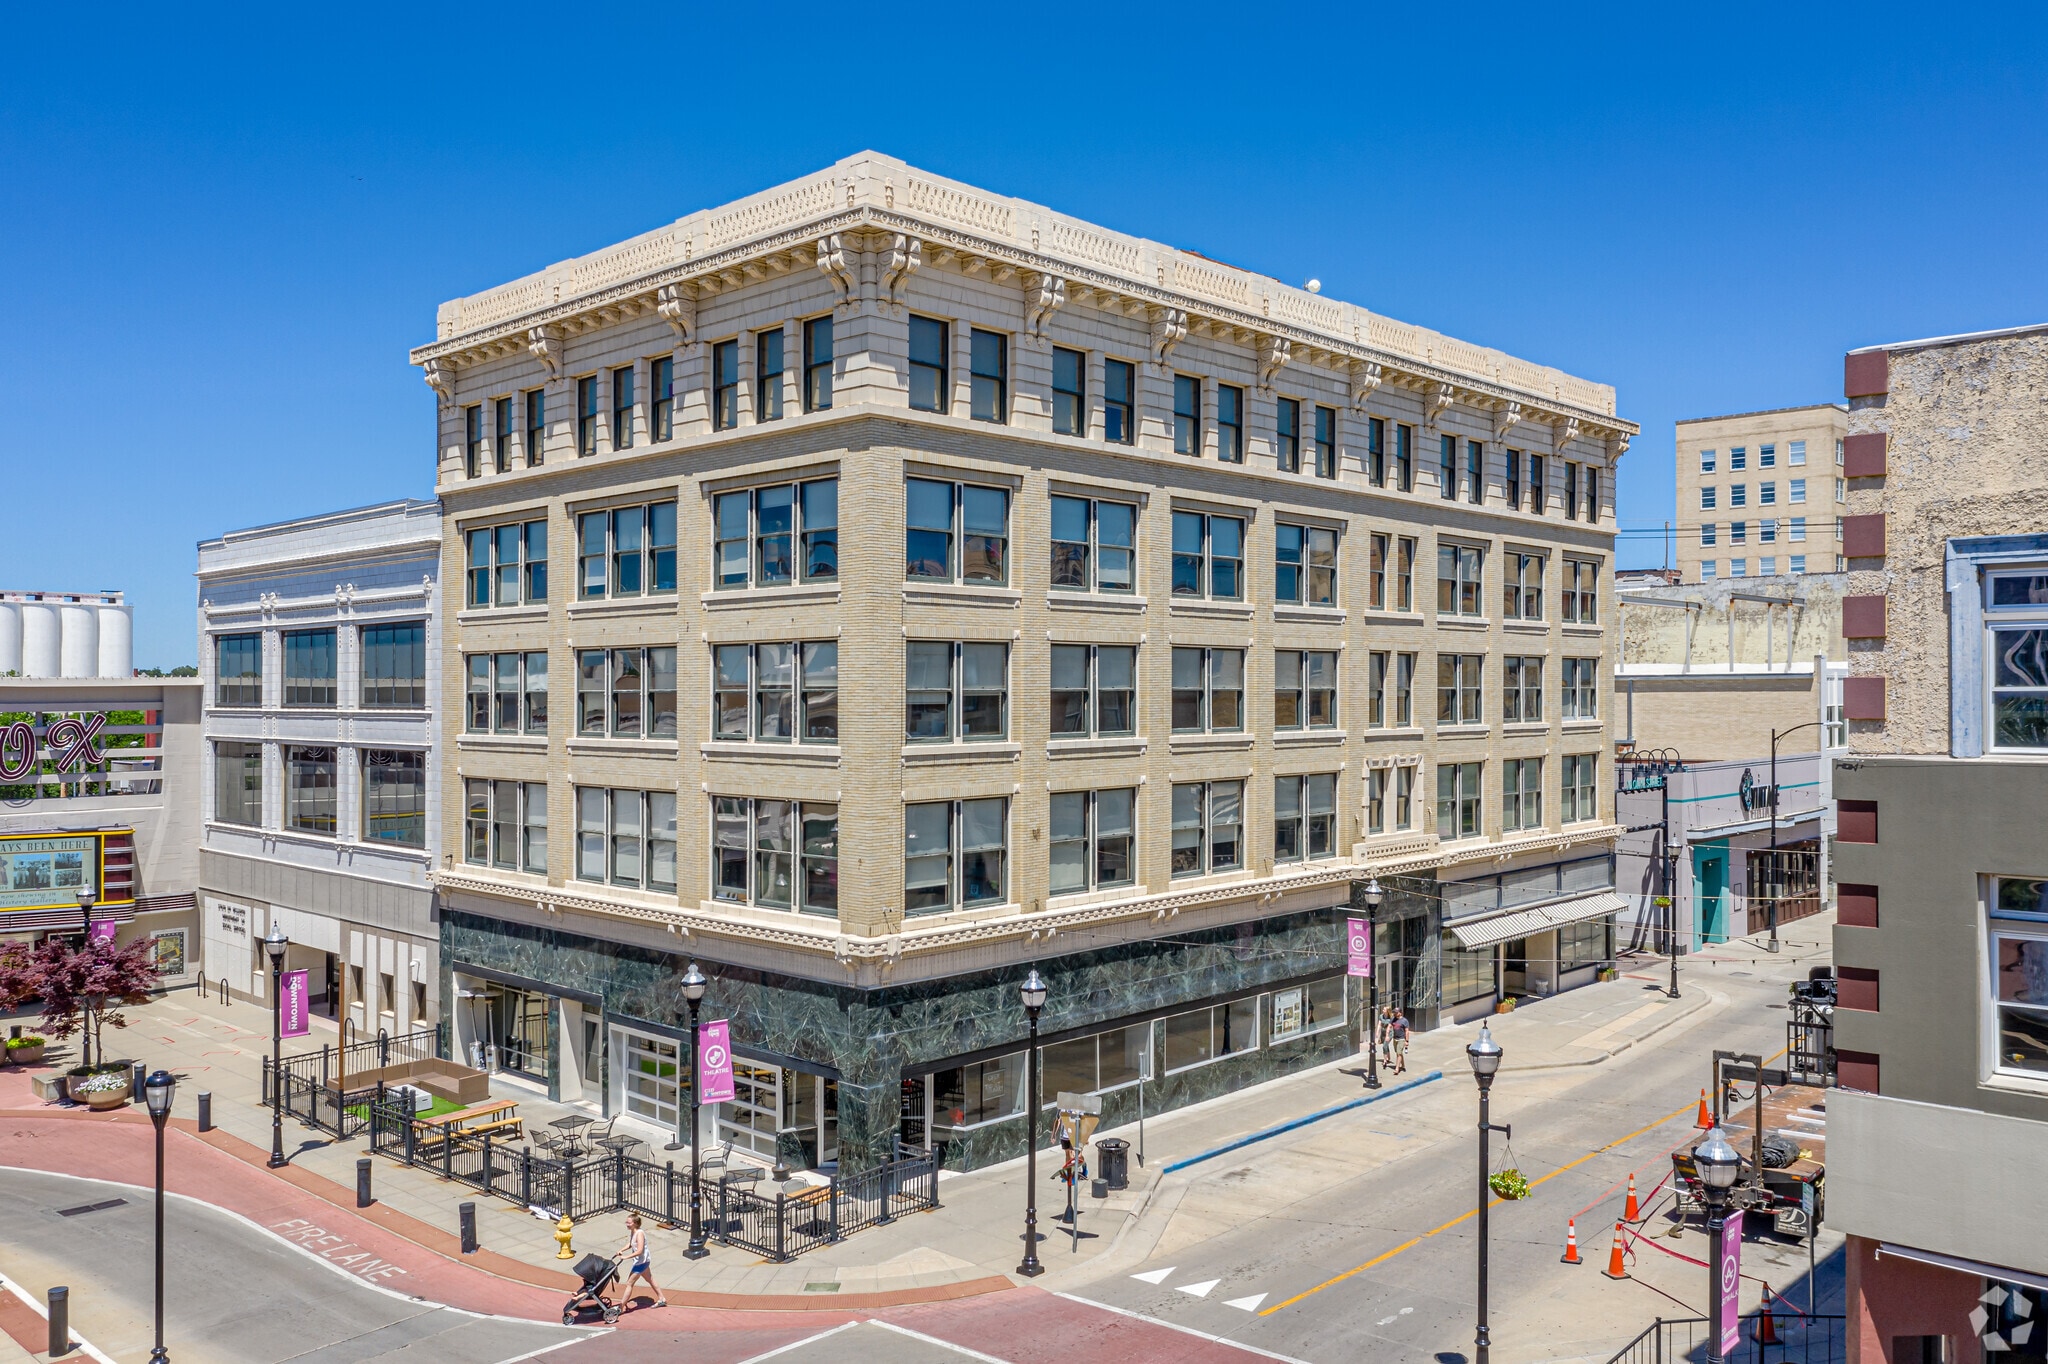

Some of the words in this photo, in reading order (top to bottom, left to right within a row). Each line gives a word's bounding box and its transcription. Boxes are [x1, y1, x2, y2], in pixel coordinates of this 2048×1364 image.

[27, 841, 55, 851] BEEN
[60, 840, 89, 850] HERE
[704, 1068, 729, 1076] THEATRE
[268, 1218, 343, 1249] FIRE
[318, 1242, 408, 1282] LANE
